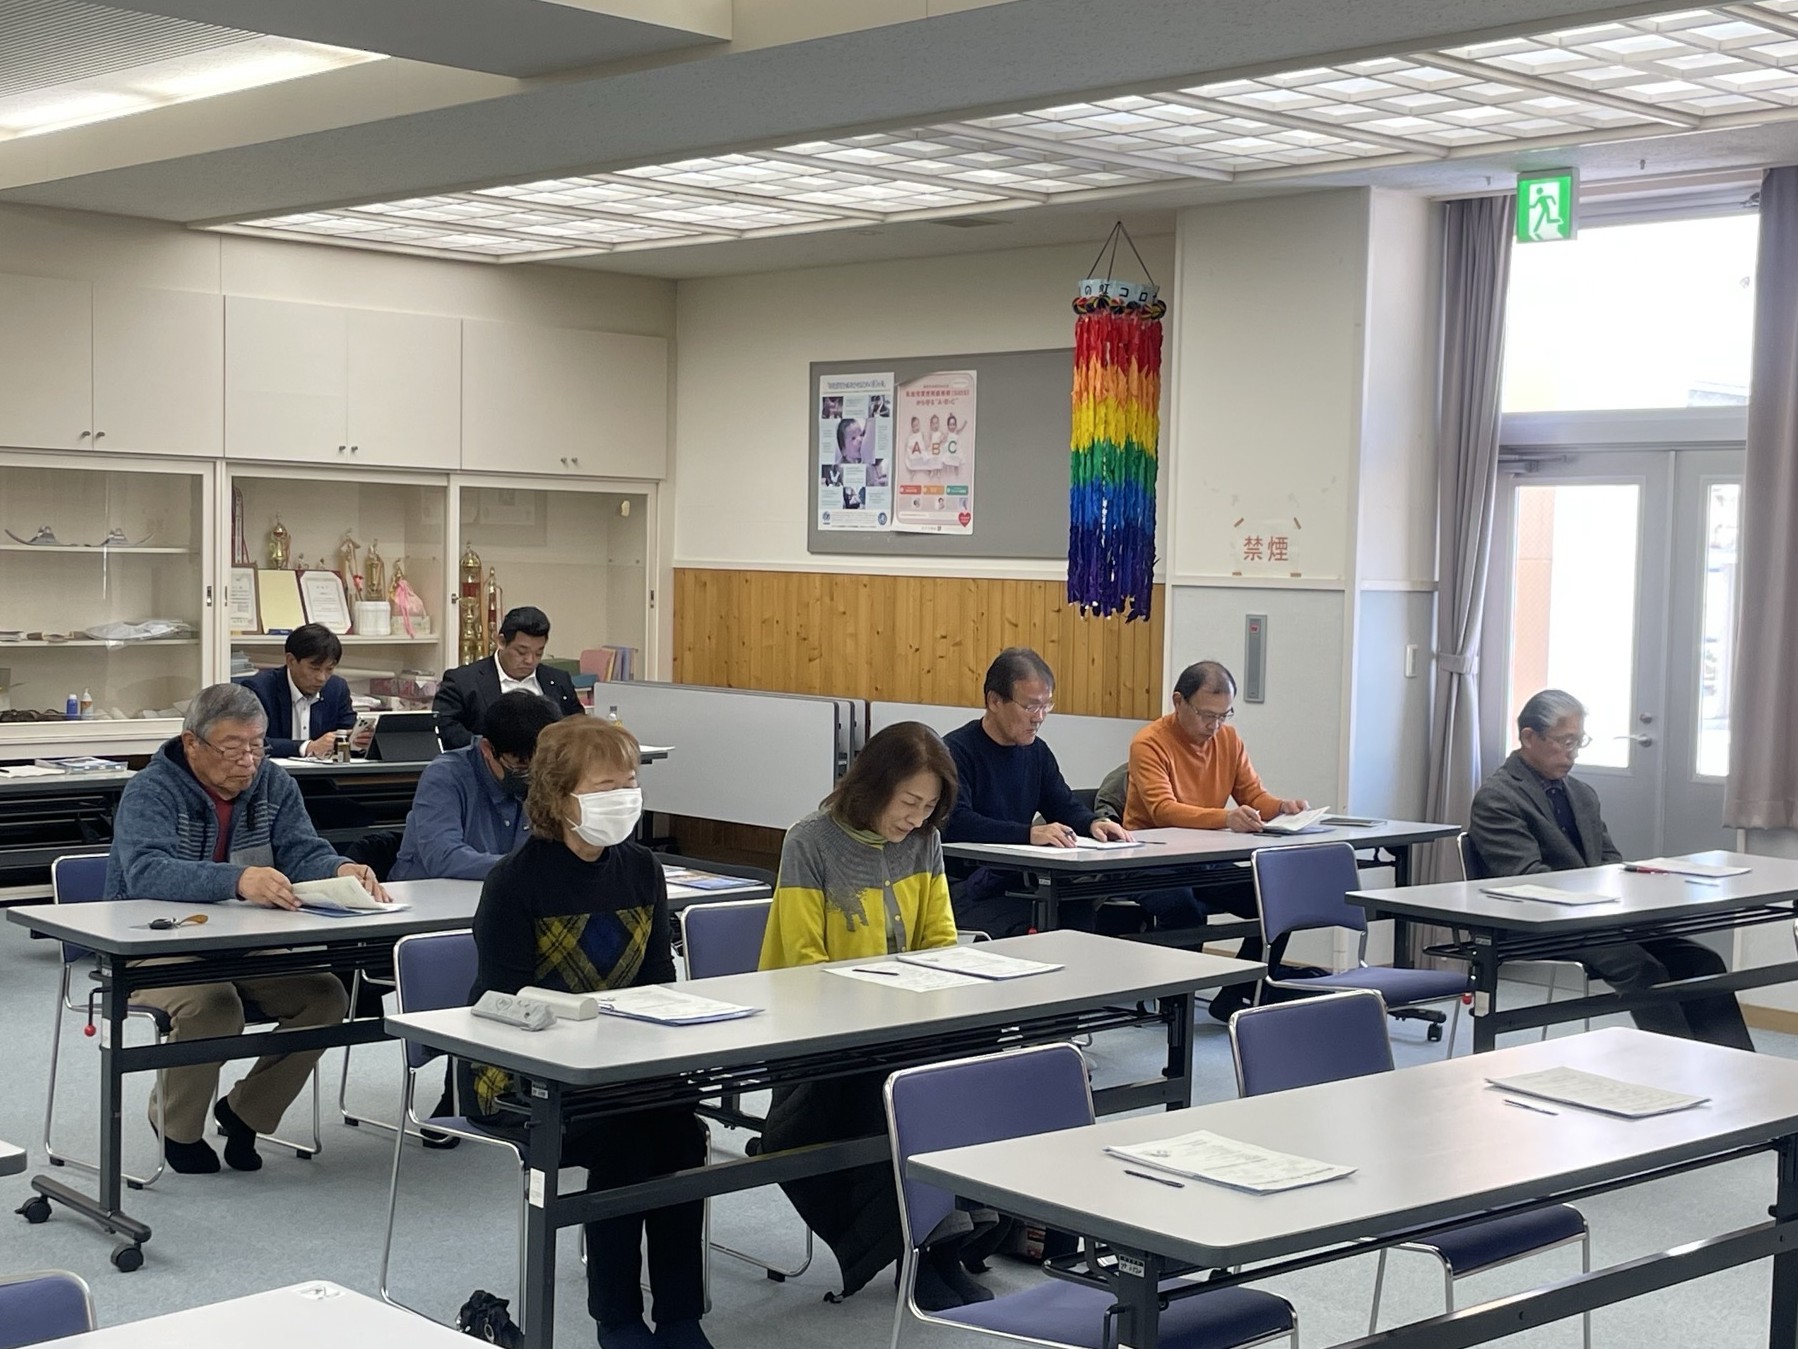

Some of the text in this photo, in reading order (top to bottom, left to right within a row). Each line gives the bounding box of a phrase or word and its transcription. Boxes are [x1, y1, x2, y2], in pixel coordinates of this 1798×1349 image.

[912, 441, 957, 455] A B C
[1243, 535, 1289, 561] 禁煙
